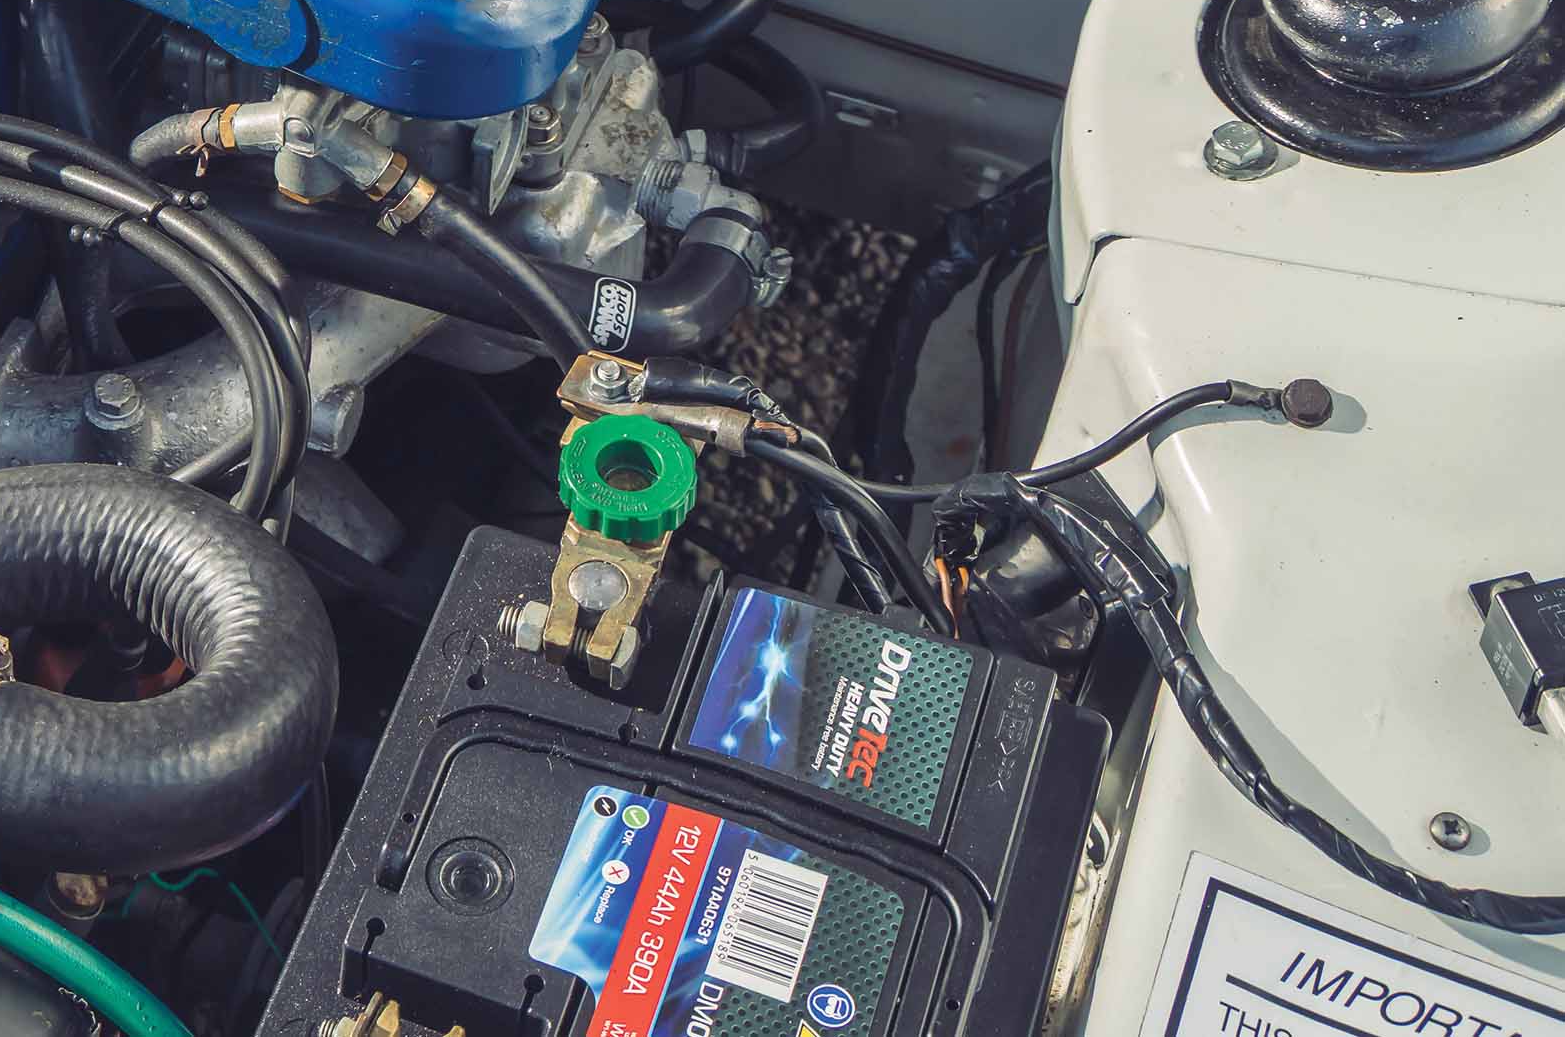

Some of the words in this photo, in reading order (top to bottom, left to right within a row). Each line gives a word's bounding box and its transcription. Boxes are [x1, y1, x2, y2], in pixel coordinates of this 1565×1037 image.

[593, 283, 617, 346] SAMCO
[613, 287, 629, 337] sport
[839, 681, 866, 738] HEAVY
[811, 740, 829, 772] battery
[826, 731, 851, 778] DUTY
[620, 829, 635, 847] OK
[671, 825, 702, 866] 12V
[748, 852, 758, 861] 5
[593, 885, 616, 924] Replace
[647, 866, 686, 927] 44Ah
[695, 865, 732, 946] 971AA0631
[622, 931, 664, 995] 390A
[1280, 952, 1523, 1037] IMPORT
